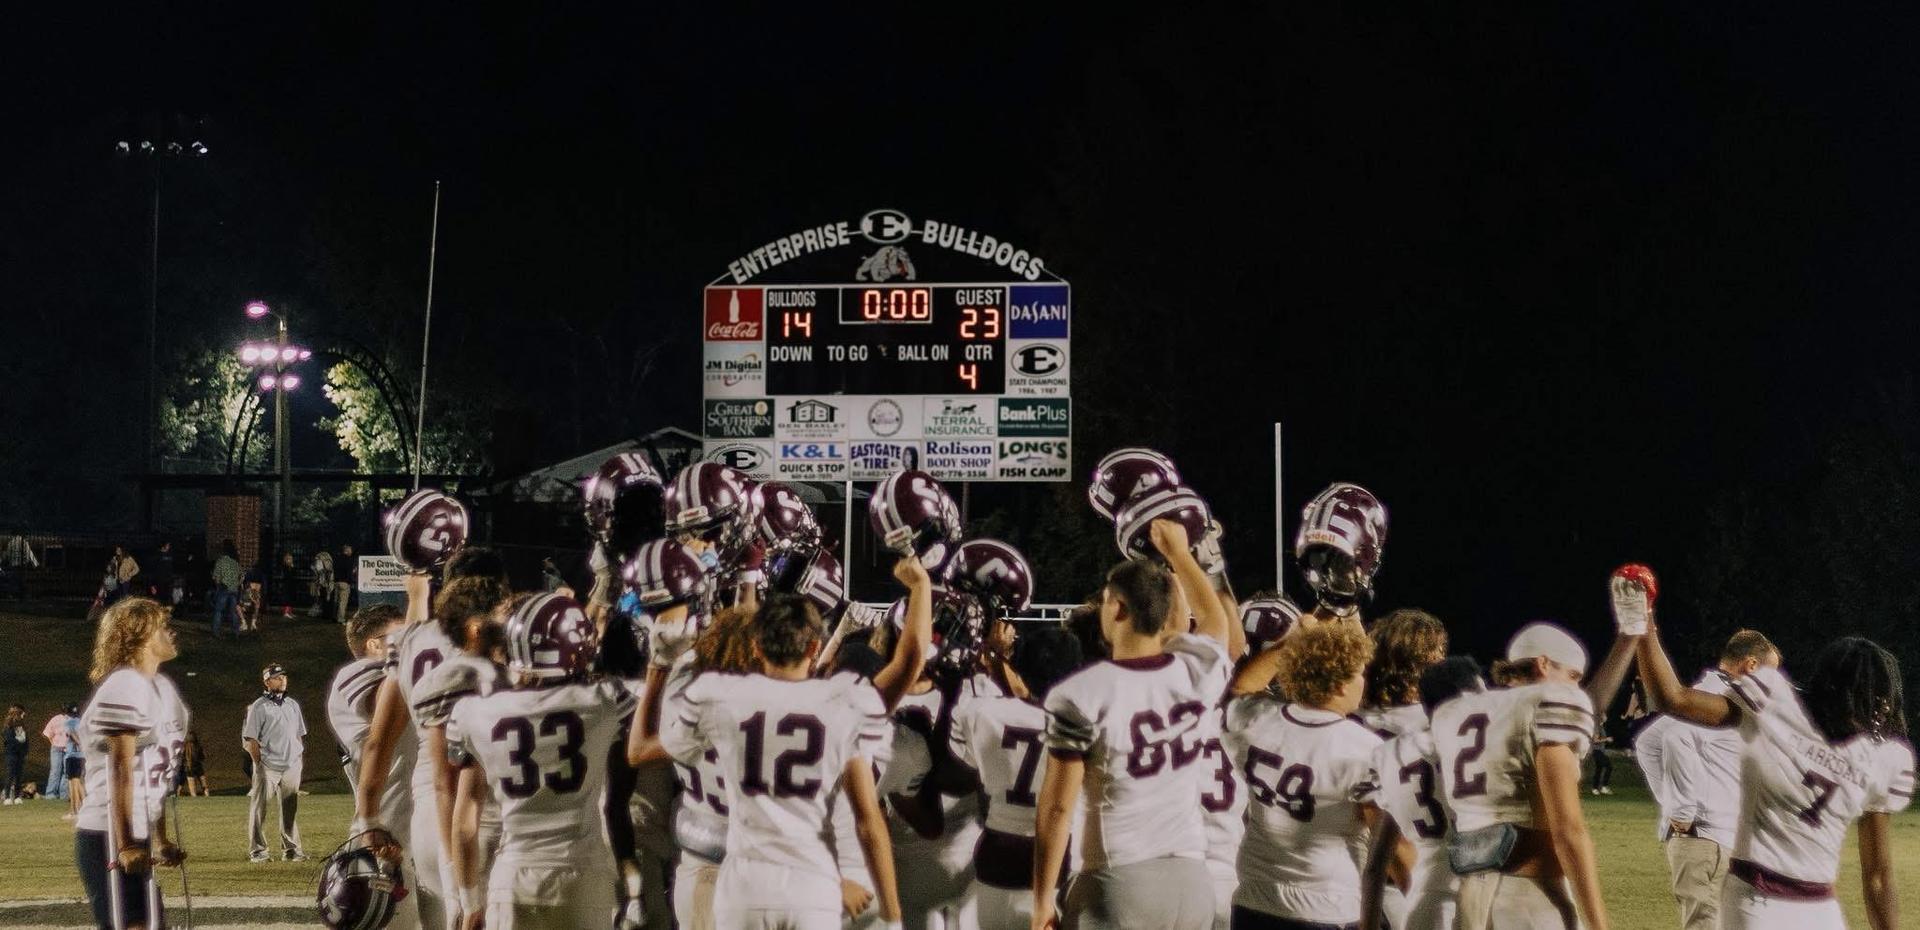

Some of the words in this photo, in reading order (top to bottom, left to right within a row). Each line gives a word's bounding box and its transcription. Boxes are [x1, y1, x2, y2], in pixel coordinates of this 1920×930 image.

[866, 213, 908, 240] E
[728, 221, 850, 284] ENTERPRISE
[922, 219, 1044, 281] BULLDOGS
[768, 291, 816, 307] BULLDOGS
[864, 289, 929, 319] 0:00
[956, 289, 1002, 305] GUEST
[1011, 301, 1067, 324] DASANI
[784, 312, 812, 338] 14
[960, 308, 999, 338] 23
[770, 345, 812, 362] DOWN
[827, 345, 845, 361] TO
[848, 345, 868, 361] GO
[898, 344, 928, 361] BALL
[931, 344, 949, 361] ON
[965, 344, 993, 361] QTR
[1018, 346, 1058, 374] E
[706, 360, 721, 369] JM
[725, 360, 762, 372] Digital
[960, 364, 977, 390] 4
[1028, 378, 1067, 386] CHAMPIONS
[715, 401, 755, 415] GREAT
[1000, 405, 1067, 421] BankPlus
[707, 412, 771, 427] SOUTHERN
[932, 416, 985, 425] TERRAL
[723, 425, 755, 436] BANK
[925, 426, 993, 435] INSURANCE
[782, 444, 802, 458] K
[803, 444, 824, 458] &
[828, 444, 842, 458] L
[851, 443, 901, 459] EASTGATE
[926, 442, 992, 455] Rolison
[999, 442, 1067, 460] LONG'S
[780, 463, 813, 473] QUICK
[817, 463, 845, 473] STOP
[863, 458, 889, 469] TIRE
[927, 458, 956, 468] BODY
[960, 458, 991, 468] SHOP
[1000, 467, 1026, 477] FISH
[1030, 467, 1067, 477] CAMP
[362, 560, 375, 568] The
[491, 710, 588, 799] 33
[739, 710, 826, 799] 12
[1454, 712, 1490, 800] 2
[1001, 725, 1044, 807] 7
[1800, 768, 1840, 829] 7
